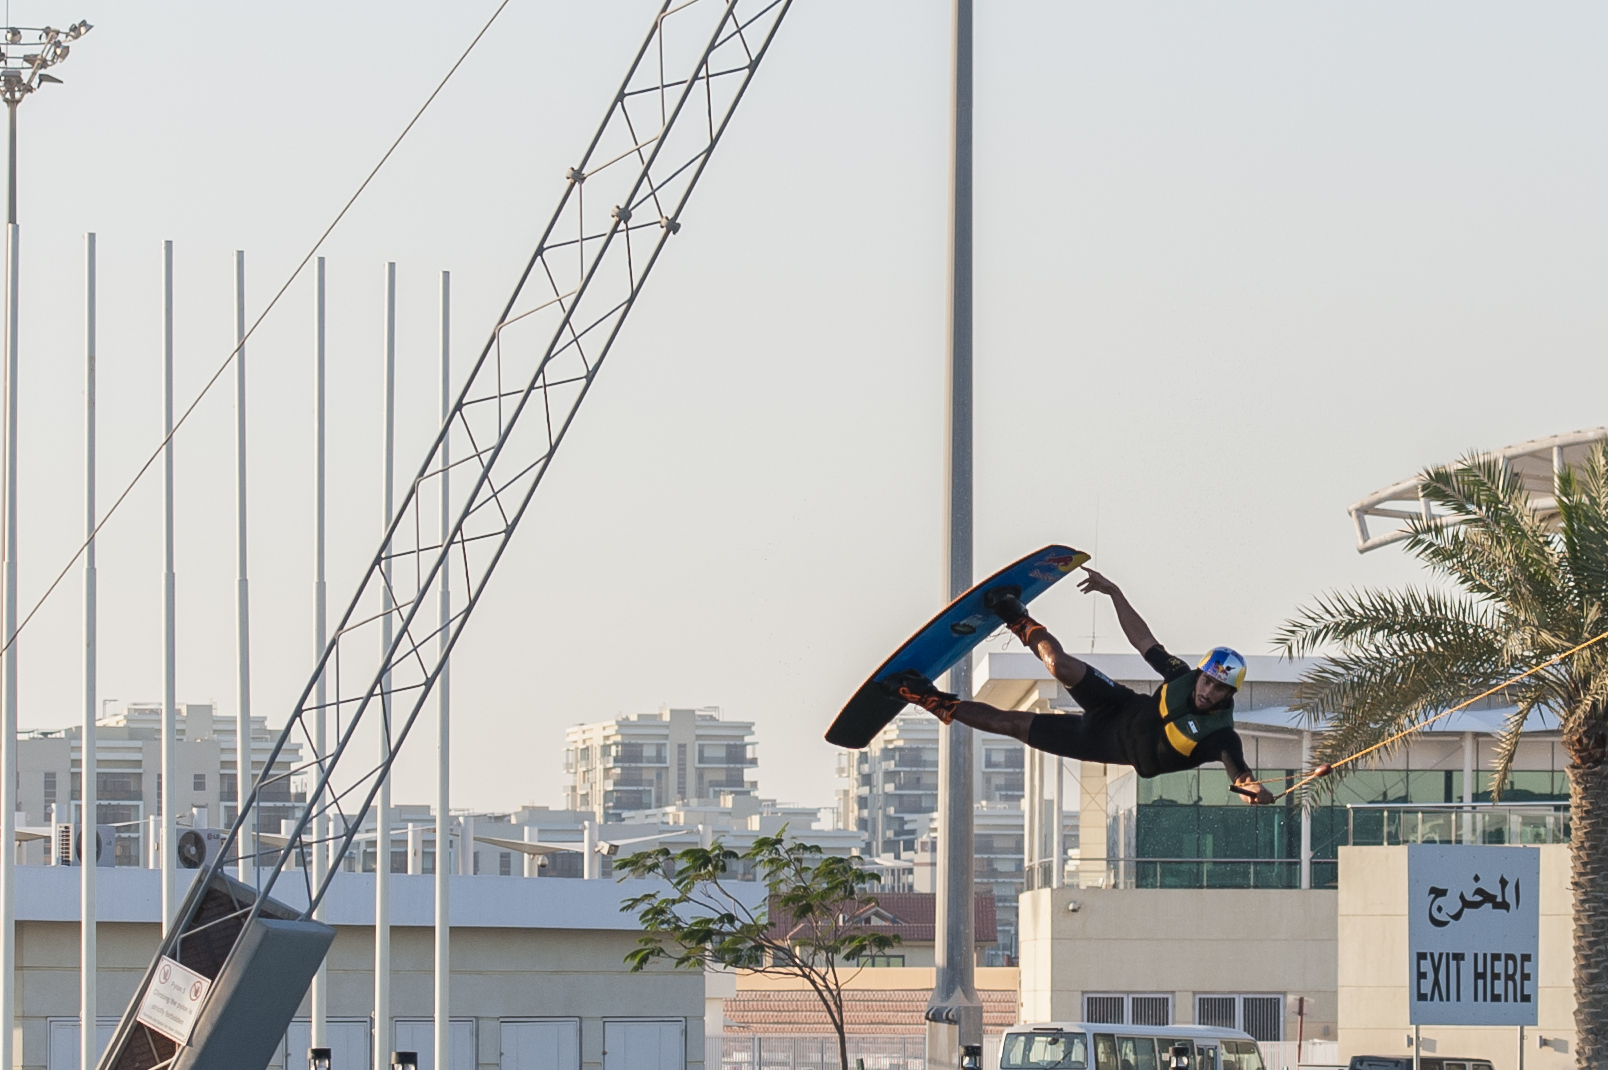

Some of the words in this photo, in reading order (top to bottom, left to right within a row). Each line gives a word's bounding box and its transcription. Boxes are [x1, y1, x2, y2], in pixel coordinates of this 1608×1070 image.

[1428, 873, 1521, 928] المخرج
[1416, 951, 1465, 1002] EXIT
[1473, 952, 1532, 1003] HERE
[151, 1004, 165, 1016] strictly
[165, 1010, 185, 1025] forbidden
[153, 989, 170, 1004] Climbing
[177, 1002, 188, 1012] pylon
